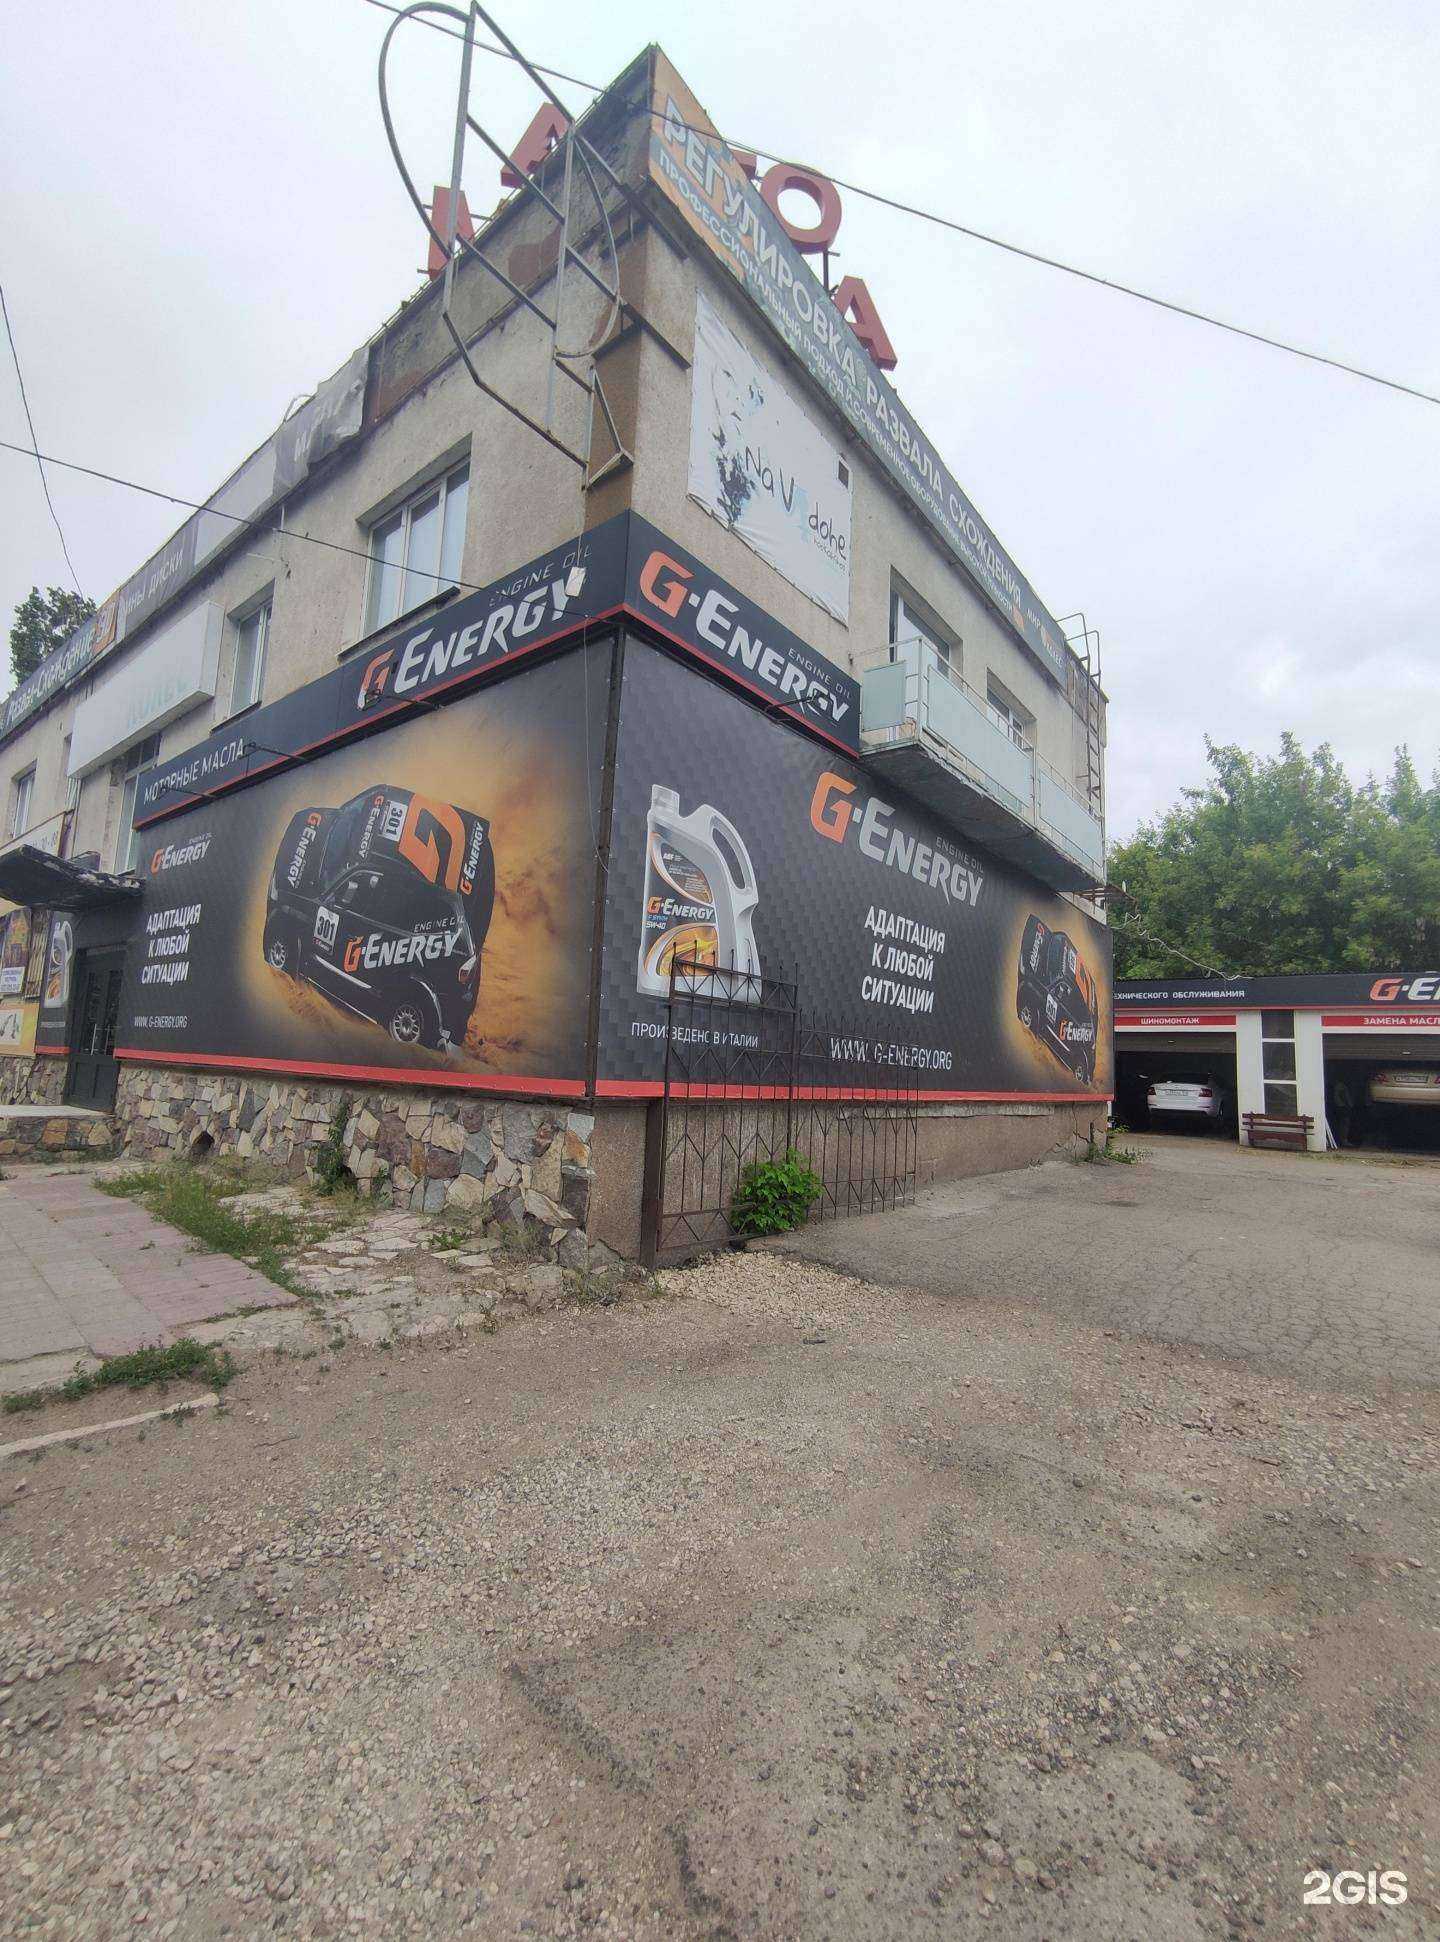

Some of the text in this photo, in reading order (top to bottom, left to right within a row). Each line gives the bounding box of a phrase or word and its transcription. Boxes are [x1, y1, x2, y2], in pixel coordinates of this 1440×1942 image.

[663, 95, 1021, 609] РЕГУЛИРОВКА РАЗВАЛА СХОЖДЕНИЯ
[357, 578, 576, 711] GENERGY
[788, 648, 832, 685] ENGINE
[201, 737, 245, 777] МАСЛА
[146, 904, 201, 933] АДАПТАЦИЯ
[317, 916, 336, 941] 301
[864, 905, 946, 954] АДАПТАЦИЯ
[155, 931, 190, 956] ЛЮБОЙ
[141, 961, 189, 986] СИТУАЦИИ
[871, 943, 934, 982] К ЛЮБОЙ
[861, 976, 935, 1015] СИТУАЦИИ
[1172, 990, 1245, 998] ОБСЛУЖИВАНИЯ
[1140, 1017, 1200, 1025] ШИНОМОНТАЖ
[1363, 1017, 1407, 1025] ЗАМЕНА
